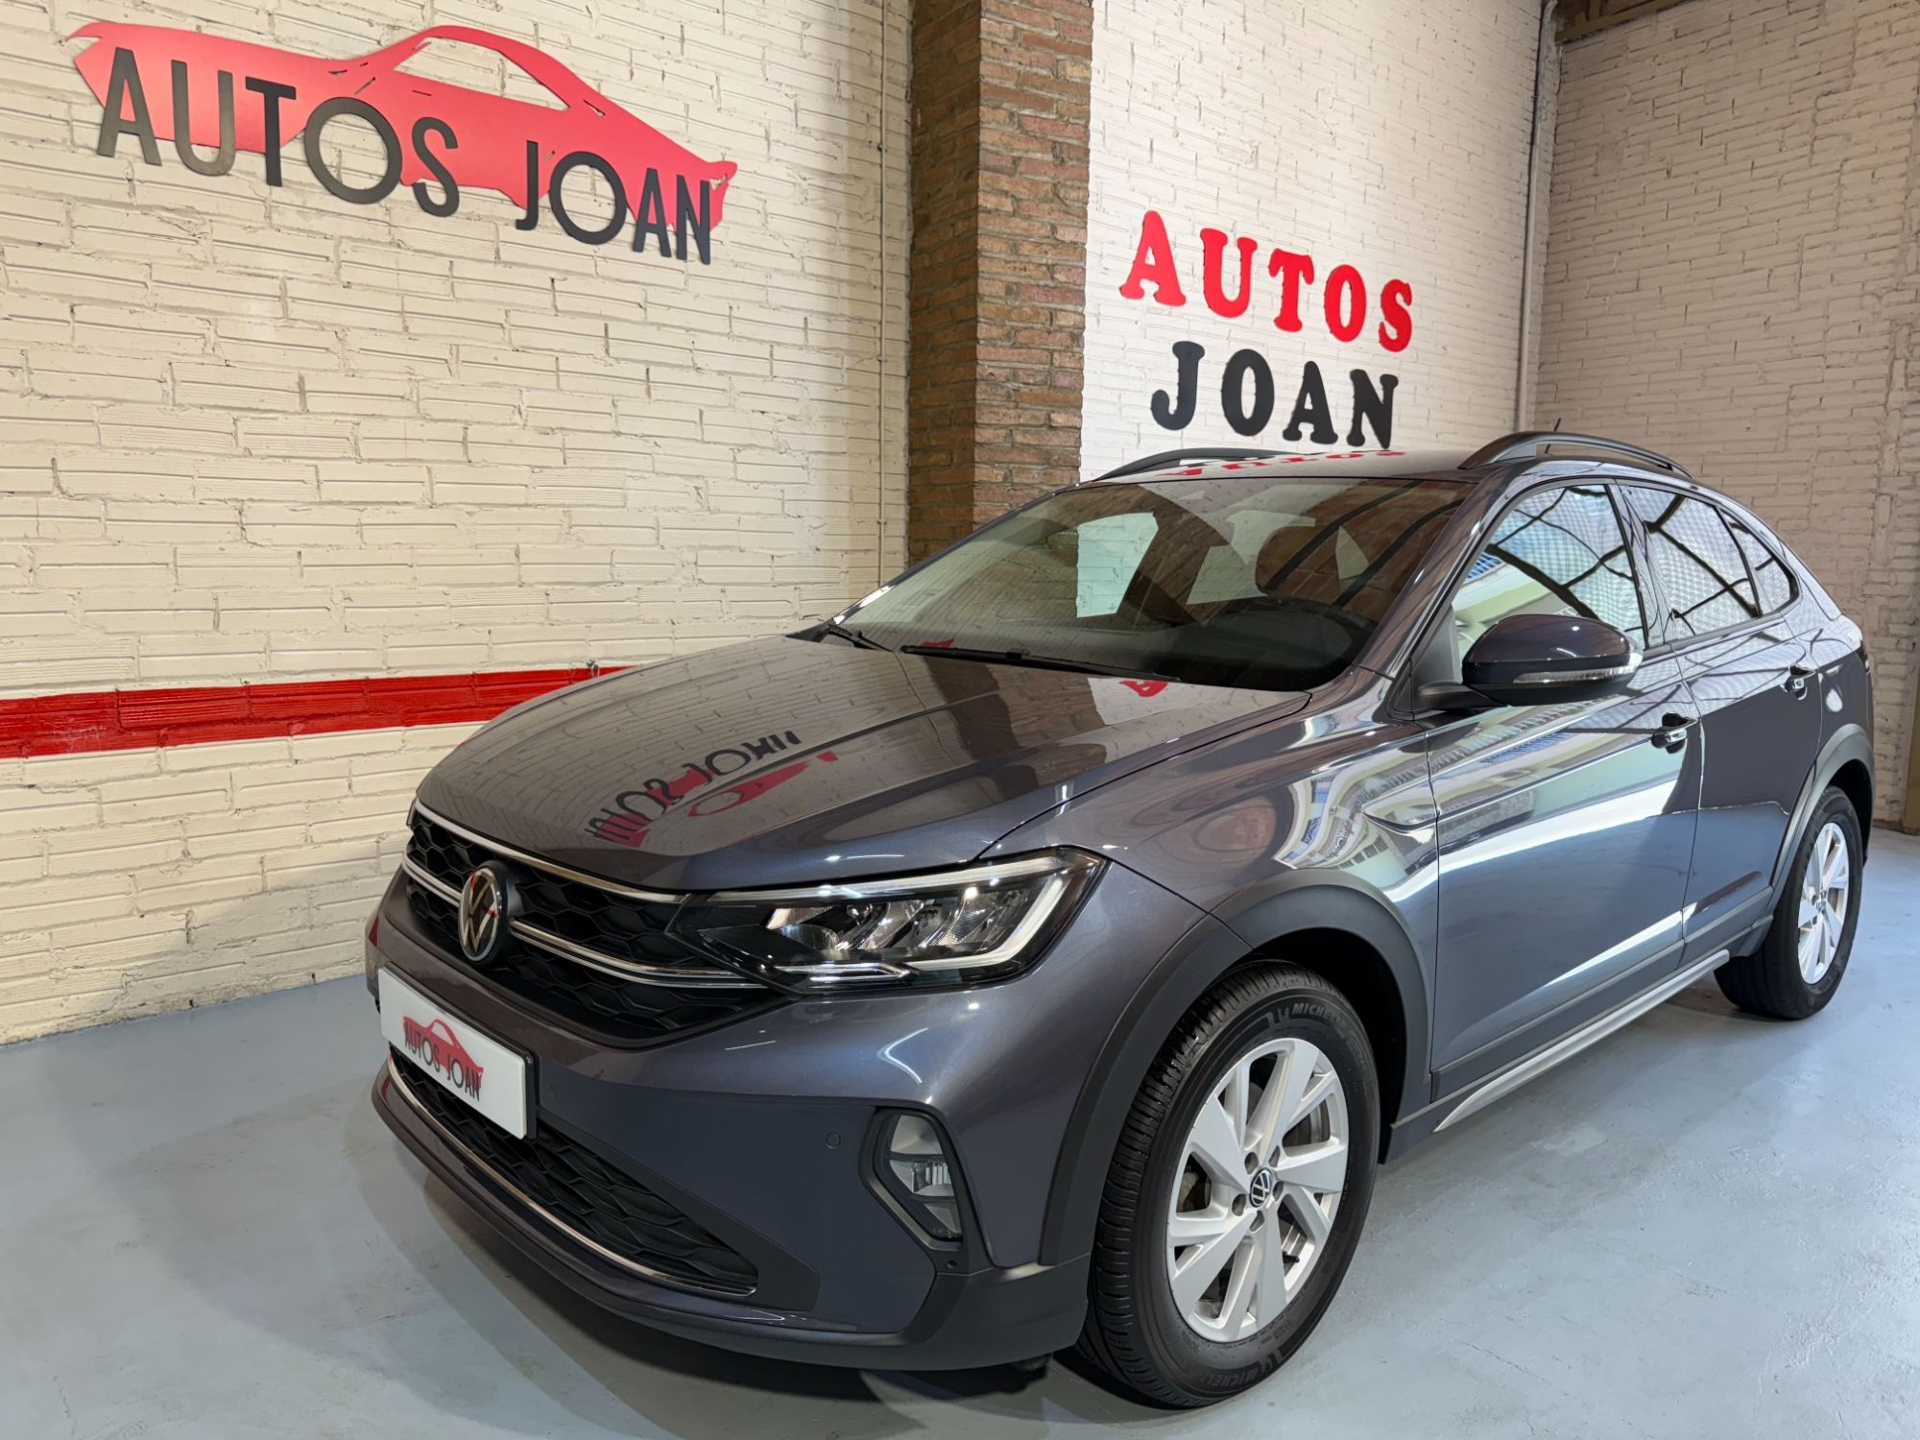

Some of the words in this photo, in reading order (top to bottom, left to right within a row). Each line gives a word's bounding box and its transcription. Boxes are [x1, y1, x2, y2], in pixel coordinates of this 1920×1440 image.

[96, 46, 460, 218] AUTOS
[515, 139, 711, 265] JOAN
[1119, 210, 1413, 353] AUTOS
[1150, 340, 1399, 449] JOAN
[404, 1021, 440, 1073] AUTOS
[447, 1053, 480, 1102] JOAN
